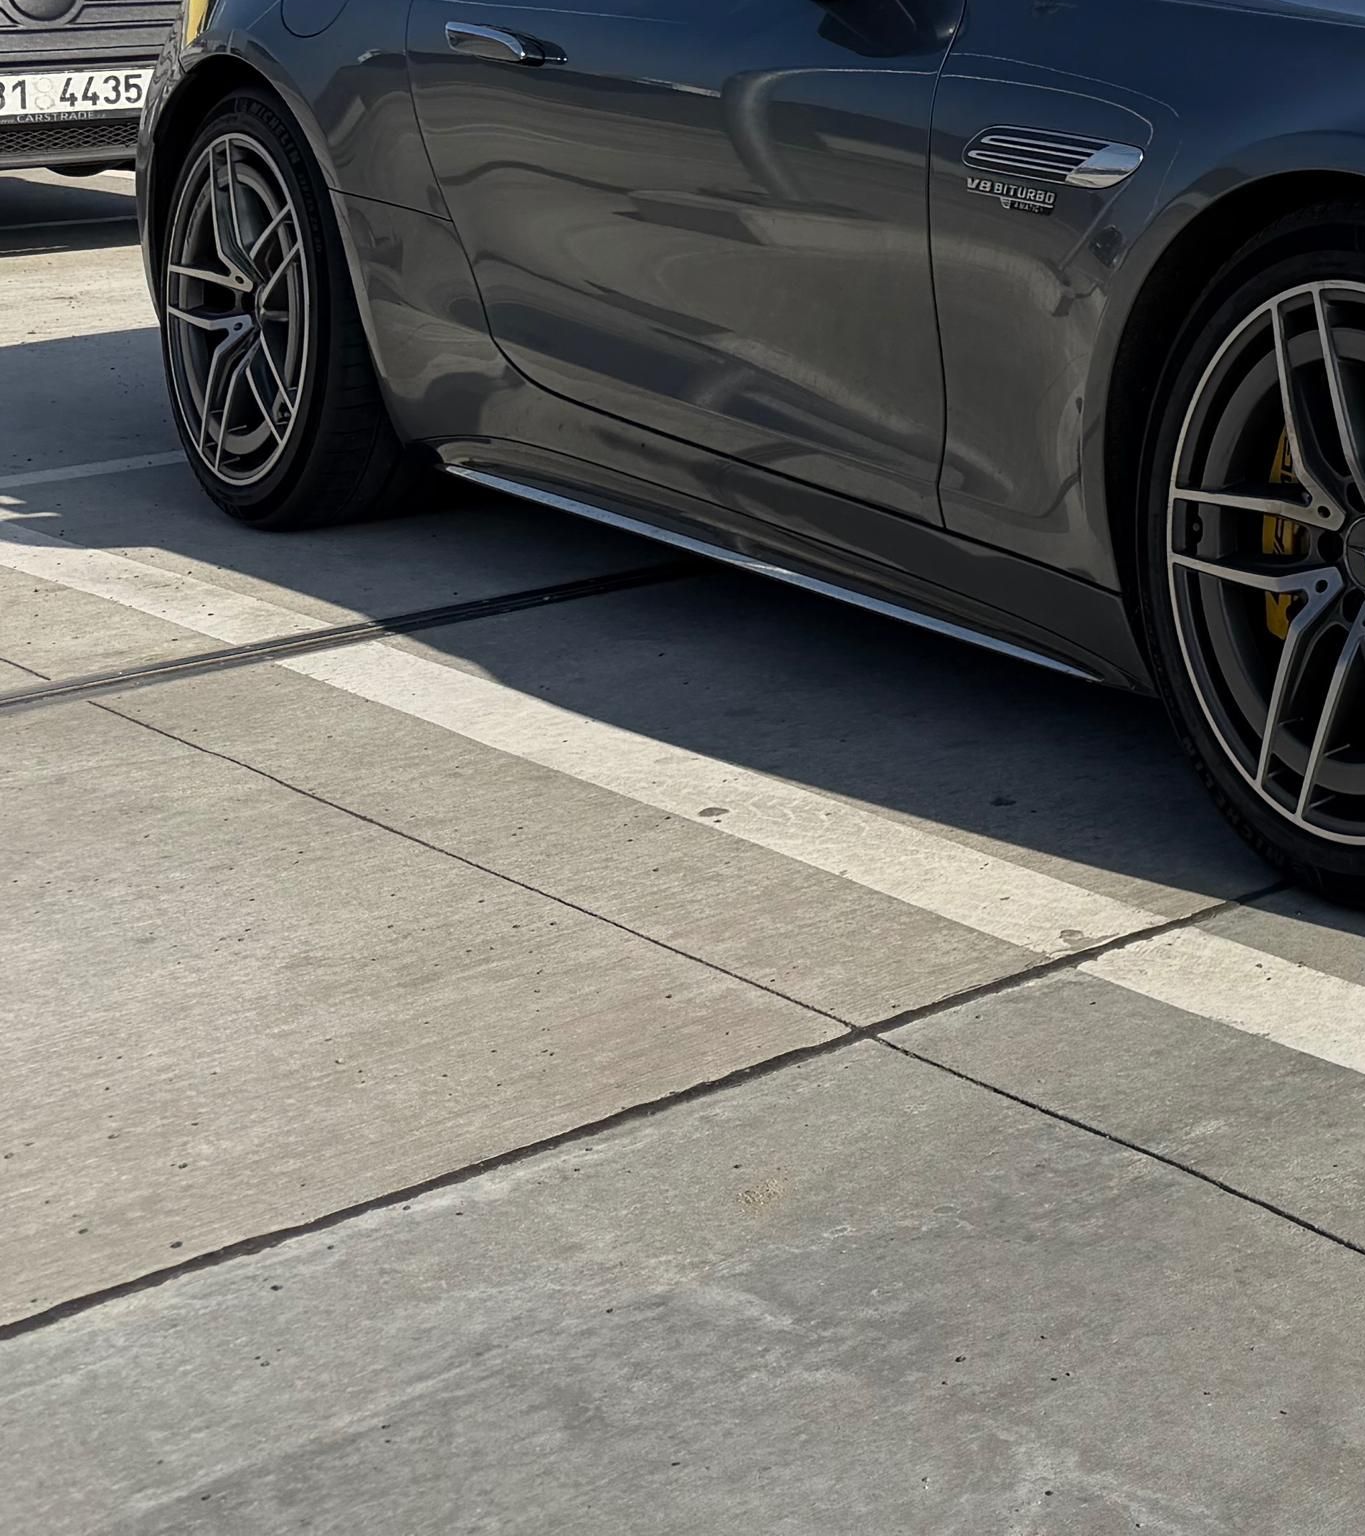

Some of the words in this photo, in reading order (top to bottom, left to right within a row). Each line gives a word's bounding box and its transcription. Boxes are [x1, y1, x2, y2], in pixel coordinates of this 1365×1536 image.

[60, 74, 142, 107] 4435
[967, 177, 992, 192] V8
[994, 182, 1056, 204] BITURBO
